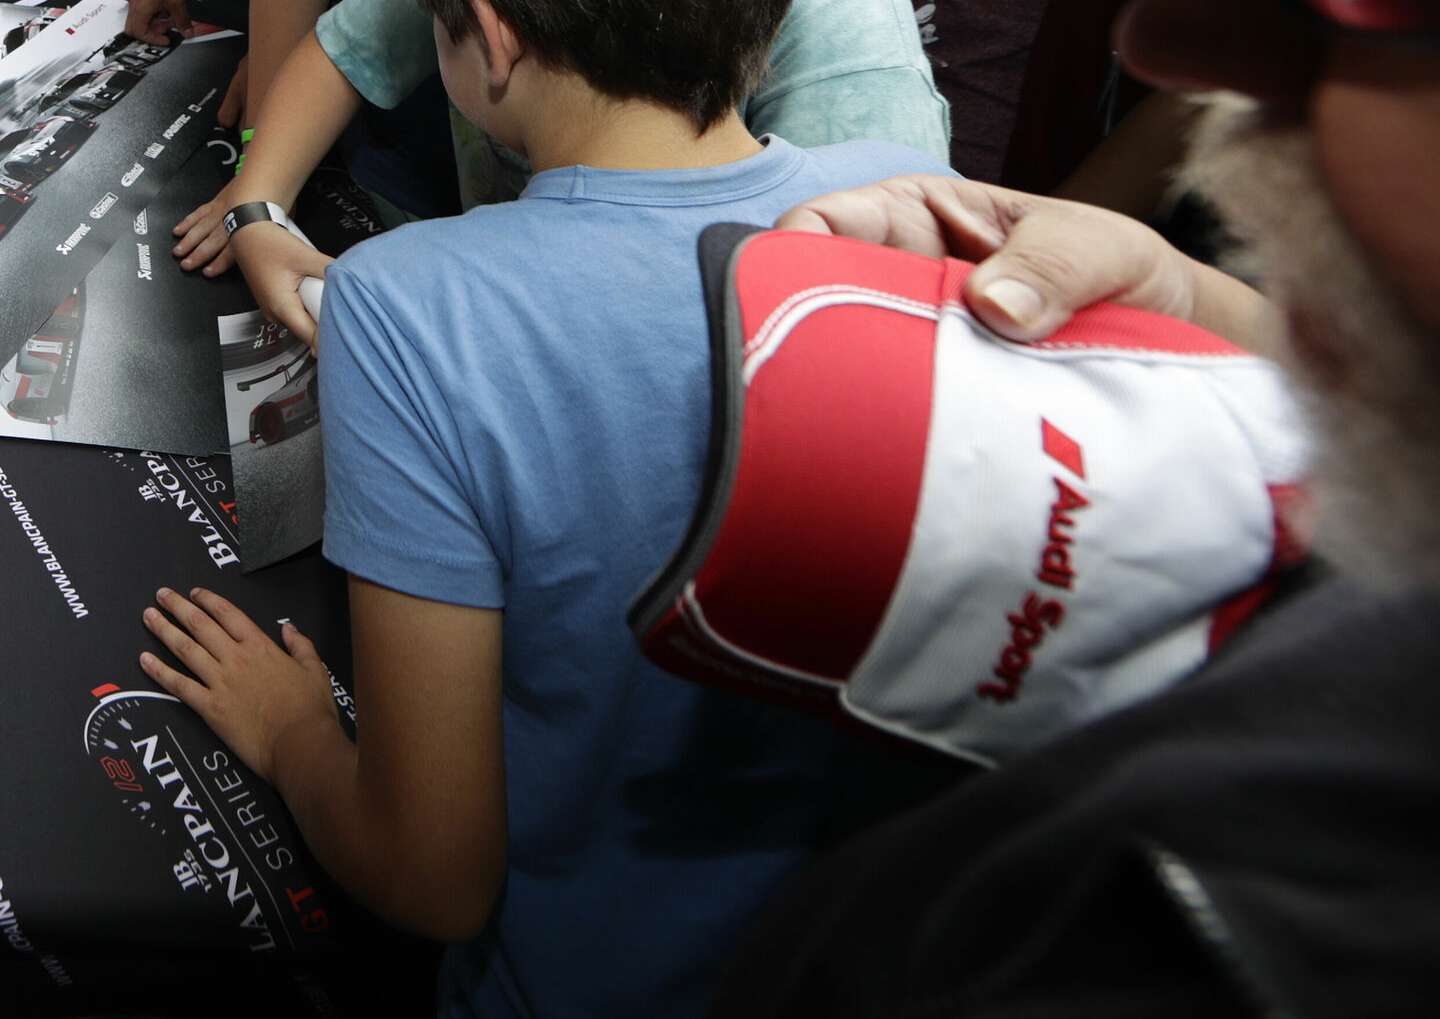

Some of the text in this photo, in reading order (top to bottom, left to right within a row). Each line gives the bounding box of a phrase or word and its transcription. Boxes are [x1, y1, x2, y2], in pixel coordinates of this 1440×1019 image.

[72, 3, 107, 30] Audi Sport
[975, 475, 1091, 706] Audi Sport
[203, 750, 294, 871] SERIES
[285, 885, 329, 933] GT
